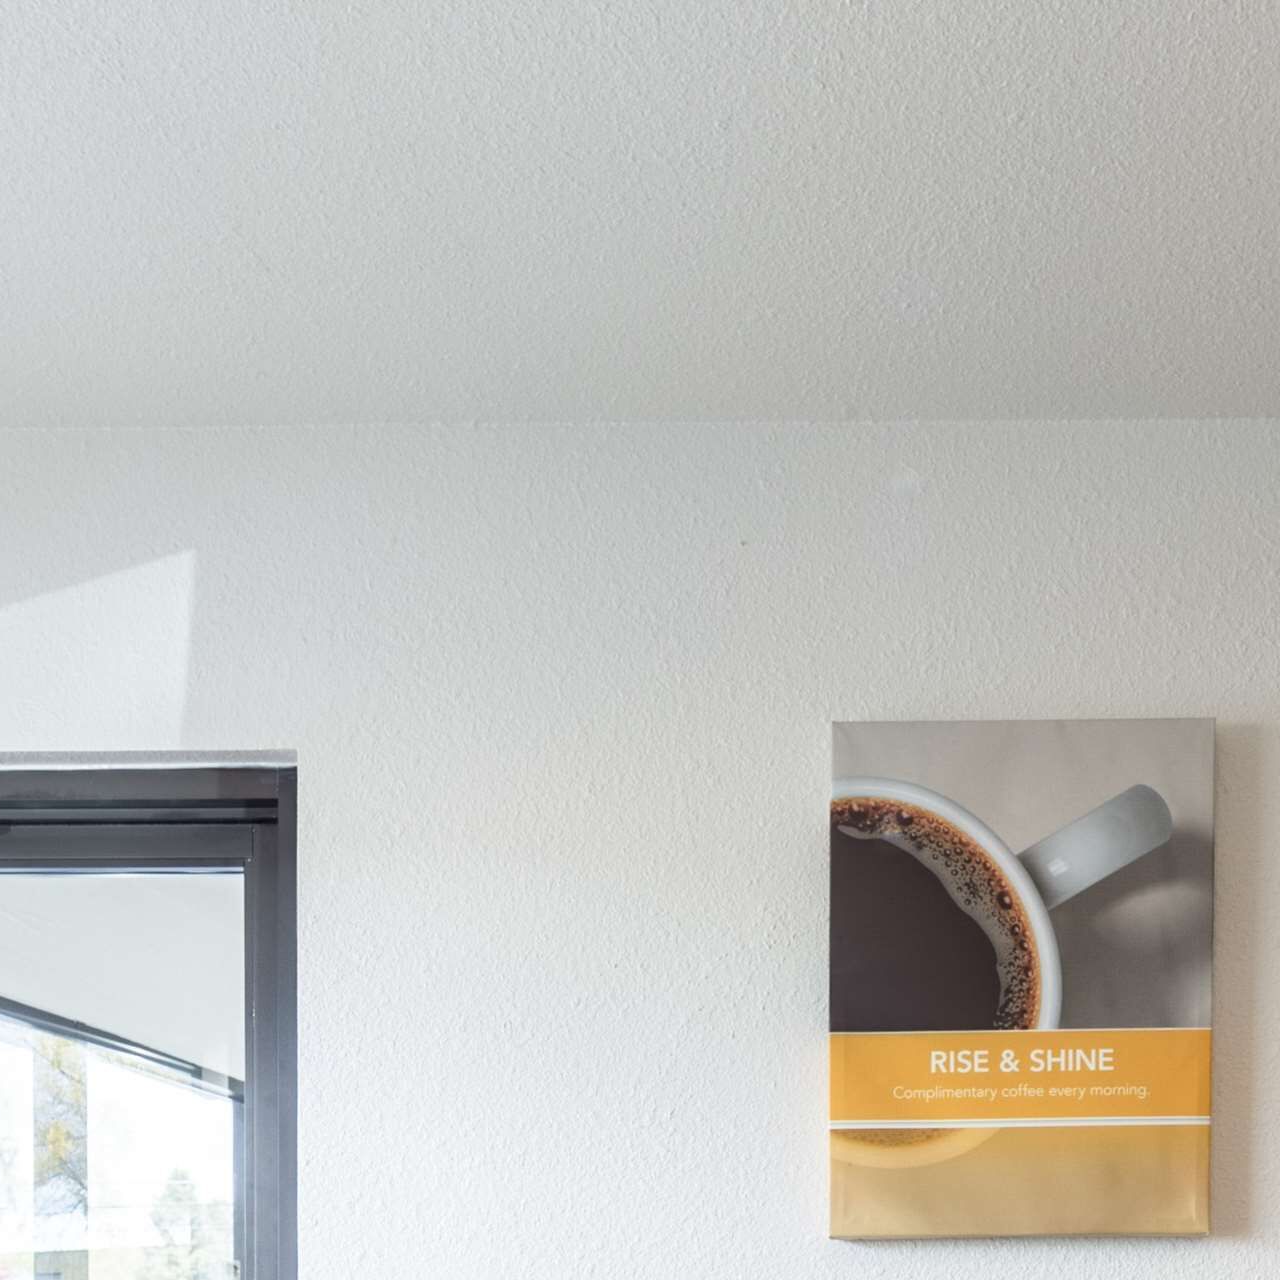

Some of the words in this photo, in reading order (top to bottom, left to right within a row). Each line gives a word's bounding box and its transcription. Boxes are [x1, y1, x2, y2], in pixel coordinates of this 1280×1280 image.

[930, 1050, 989, 1073] RISE
[999, 1049, 1020, 1073] &
[1029, 1048, 1115, 1072] SHINE
[892, 1085, 997, 1101] Complimentary
[1001, 1083, 1044, 1098] coffee
[1048, 1086, 1086, 1100] every
[1090, 1083, 1151, 1099] morning.
